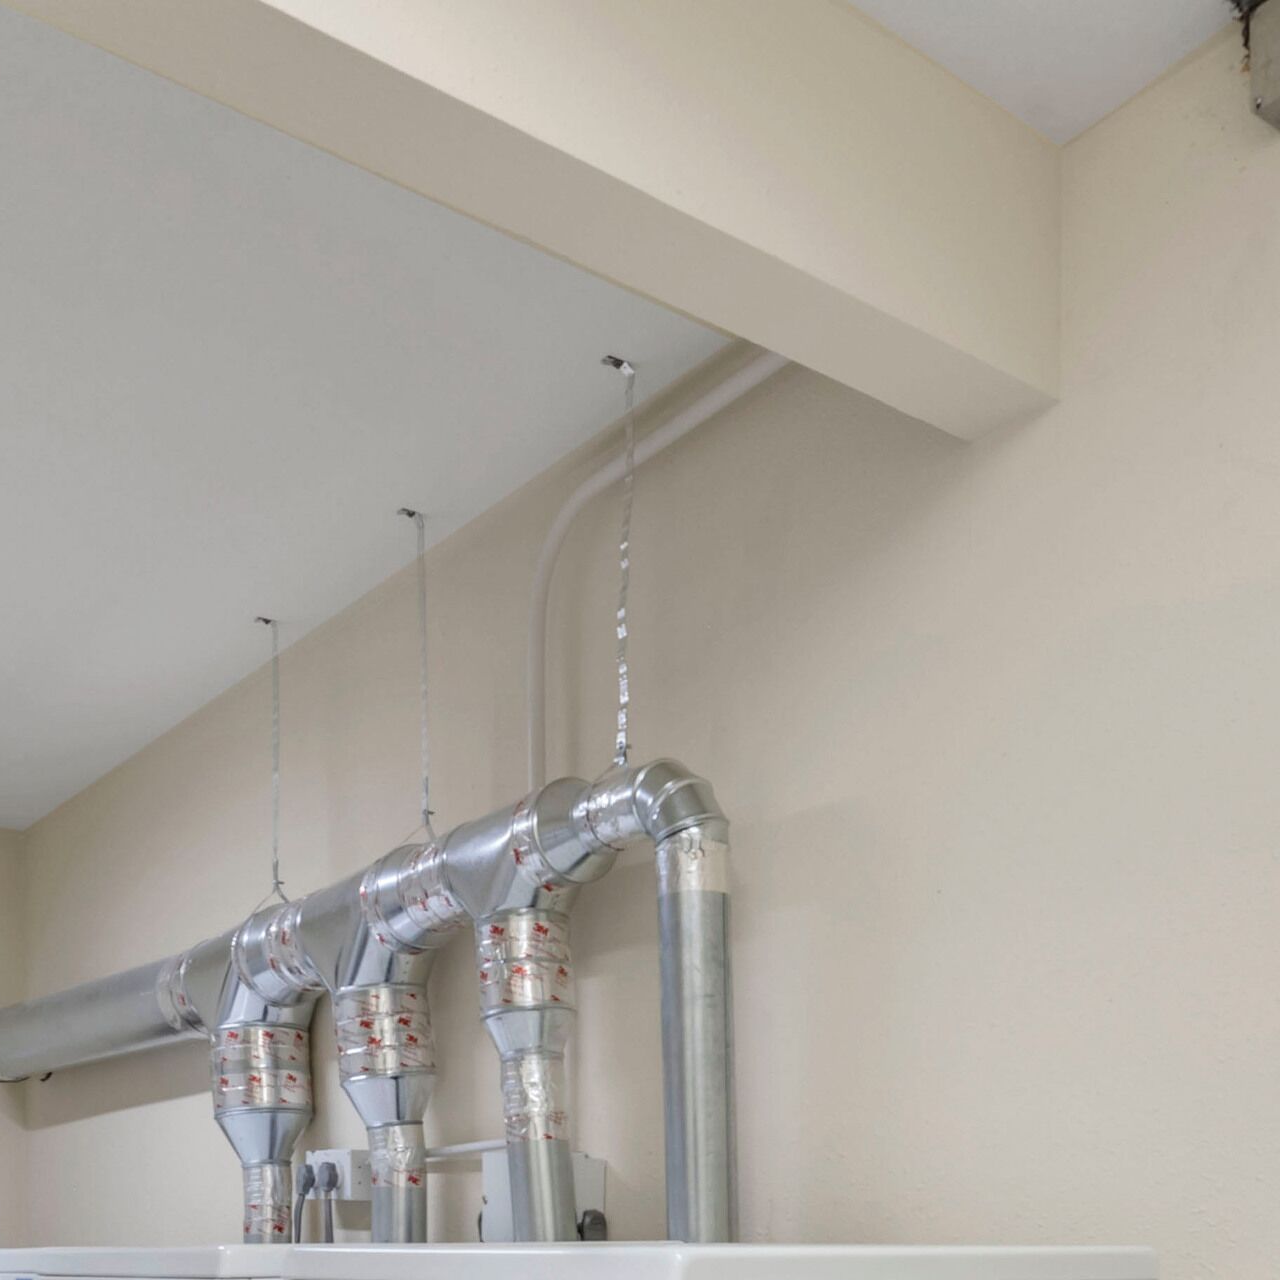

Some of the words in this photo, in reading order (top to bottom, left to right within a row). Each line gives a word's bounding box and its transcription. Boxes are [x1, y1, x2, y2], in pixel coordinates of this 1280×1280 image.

[490, 925, 505, 937] 3M
[533, 922, 549, 936] 3M
[367, 1036, 382, 1047] 3M
[406, 1033, 419, 1044] 3M
